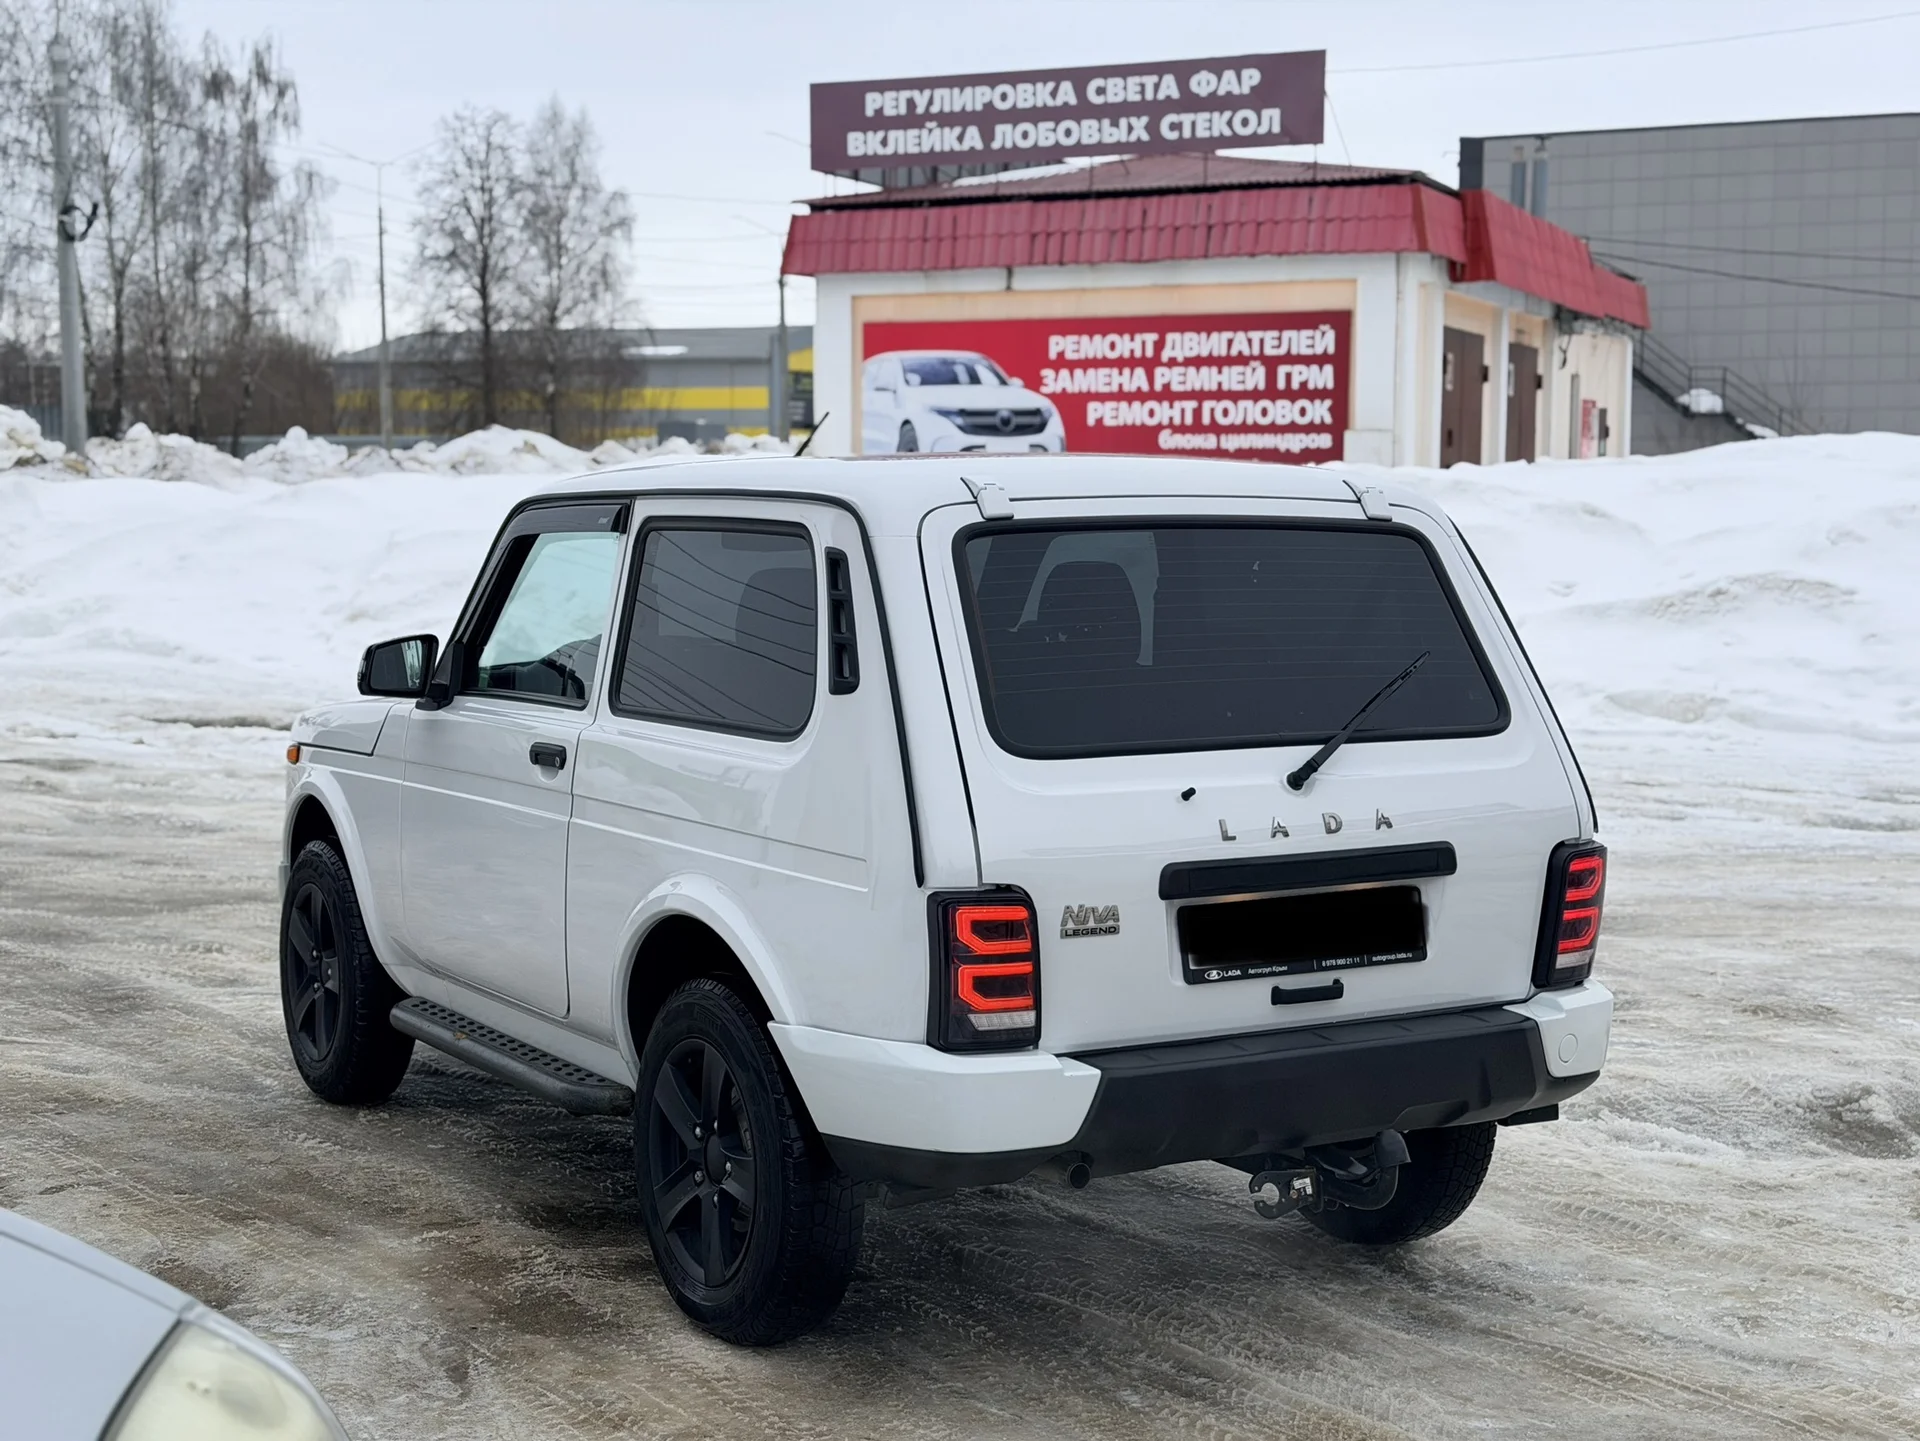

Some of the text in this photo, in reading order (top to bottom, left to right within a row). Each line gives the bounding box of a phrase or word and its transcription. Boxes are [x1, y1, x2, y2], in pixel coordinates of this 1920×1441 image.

[864, 67, 1261, 117] РЕГУЛИРОВКА СВЕТА ФАР
[846, 107, 1281, 157] ВКЛЕЙКА ЛОБОВЫХ СТЕКОЛ
[1048, 324, 1335, 363] РЕМОНТ ДВИГАТЕЛЕЙ
[1039, 360, 1334, 394] ЗАМЕНА РЕМНЕЙ ГРМ
[1086, 398, 1333, 427] РЕМОНТ ГОЛОВОК
[1158, 428, 1333, 454] блока цилиндров
[1218, 808, 1393, 842] LADA
[1060, 904, 1120, 927] NIVA
[1065, 926, 1117, 937] LEGEND
[1223, 969, 1242, 977] LADA
[1346, 957, 1353, 965] 21
